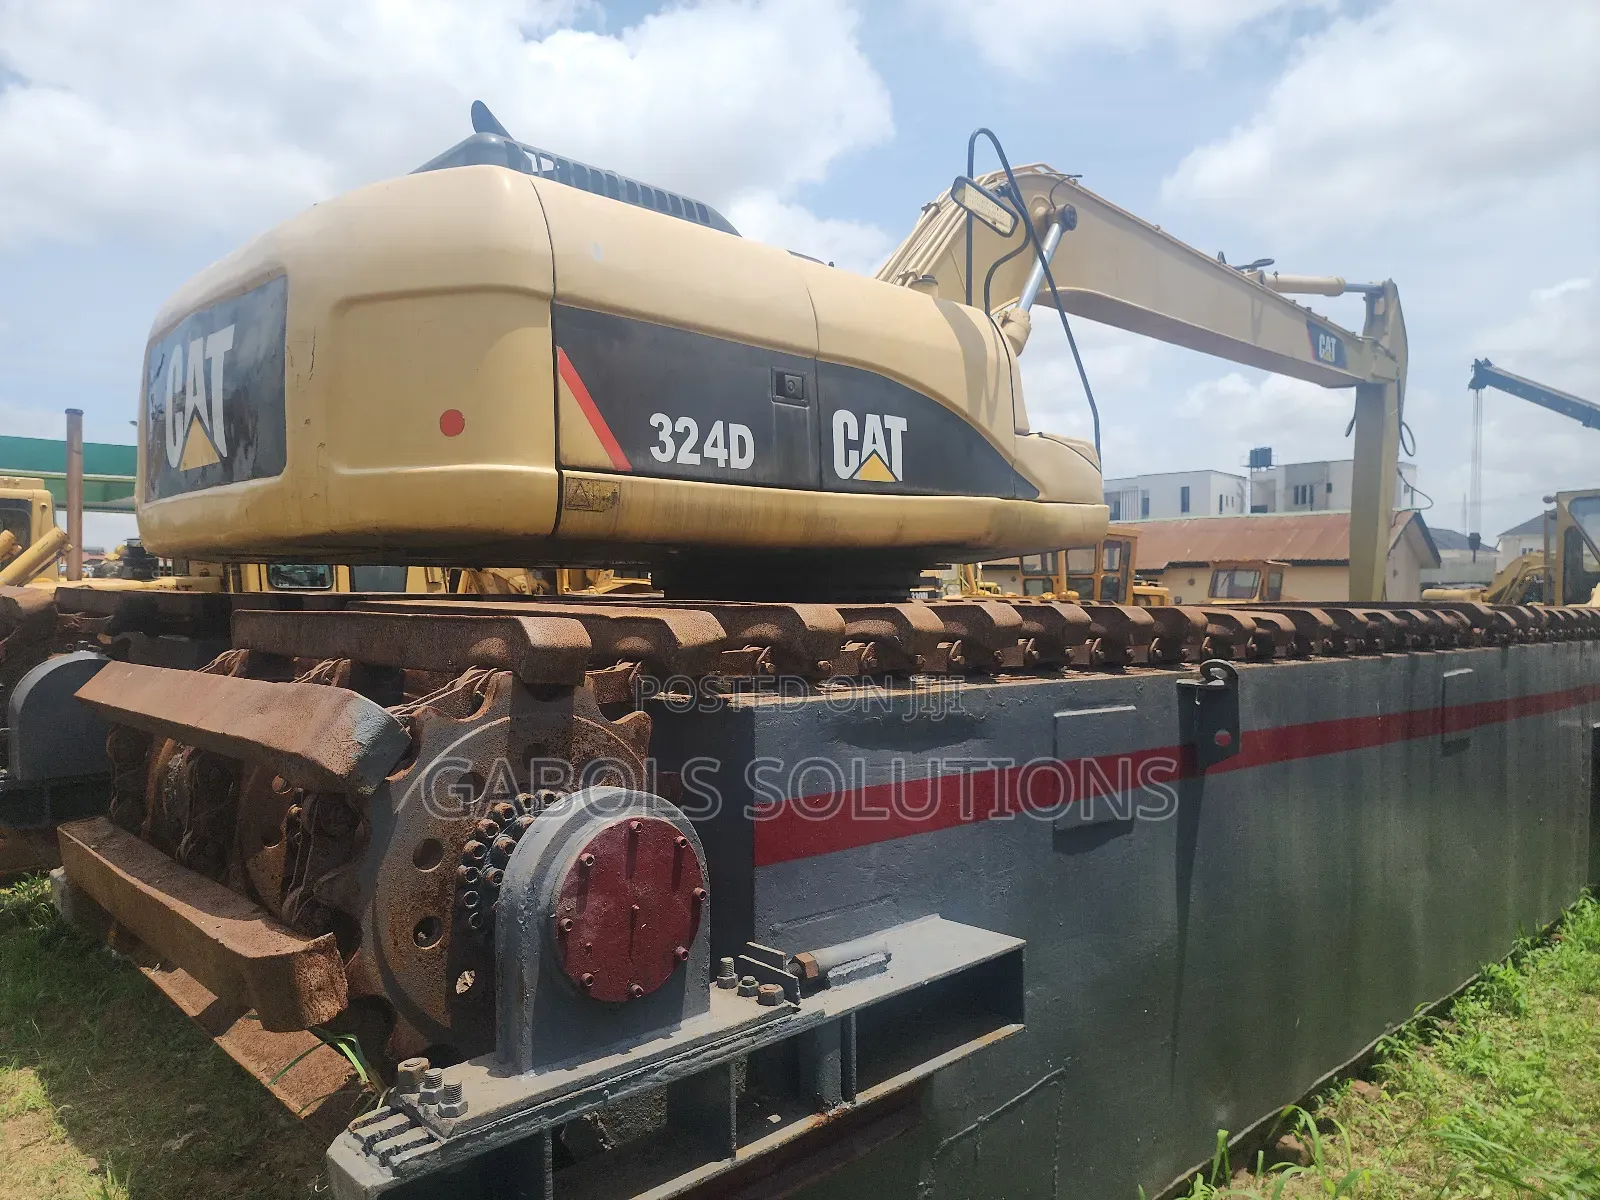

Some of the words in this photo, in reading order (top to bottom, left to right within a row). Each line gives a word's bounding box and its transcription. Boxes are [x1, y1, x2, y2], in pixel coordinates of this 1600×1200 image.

[1319, 333, 1336, 362] CAT
[166, 324, 235, 468] CAT
[649, 412, 754, 470] 324D
[832, 409, 907, 482] CAT
